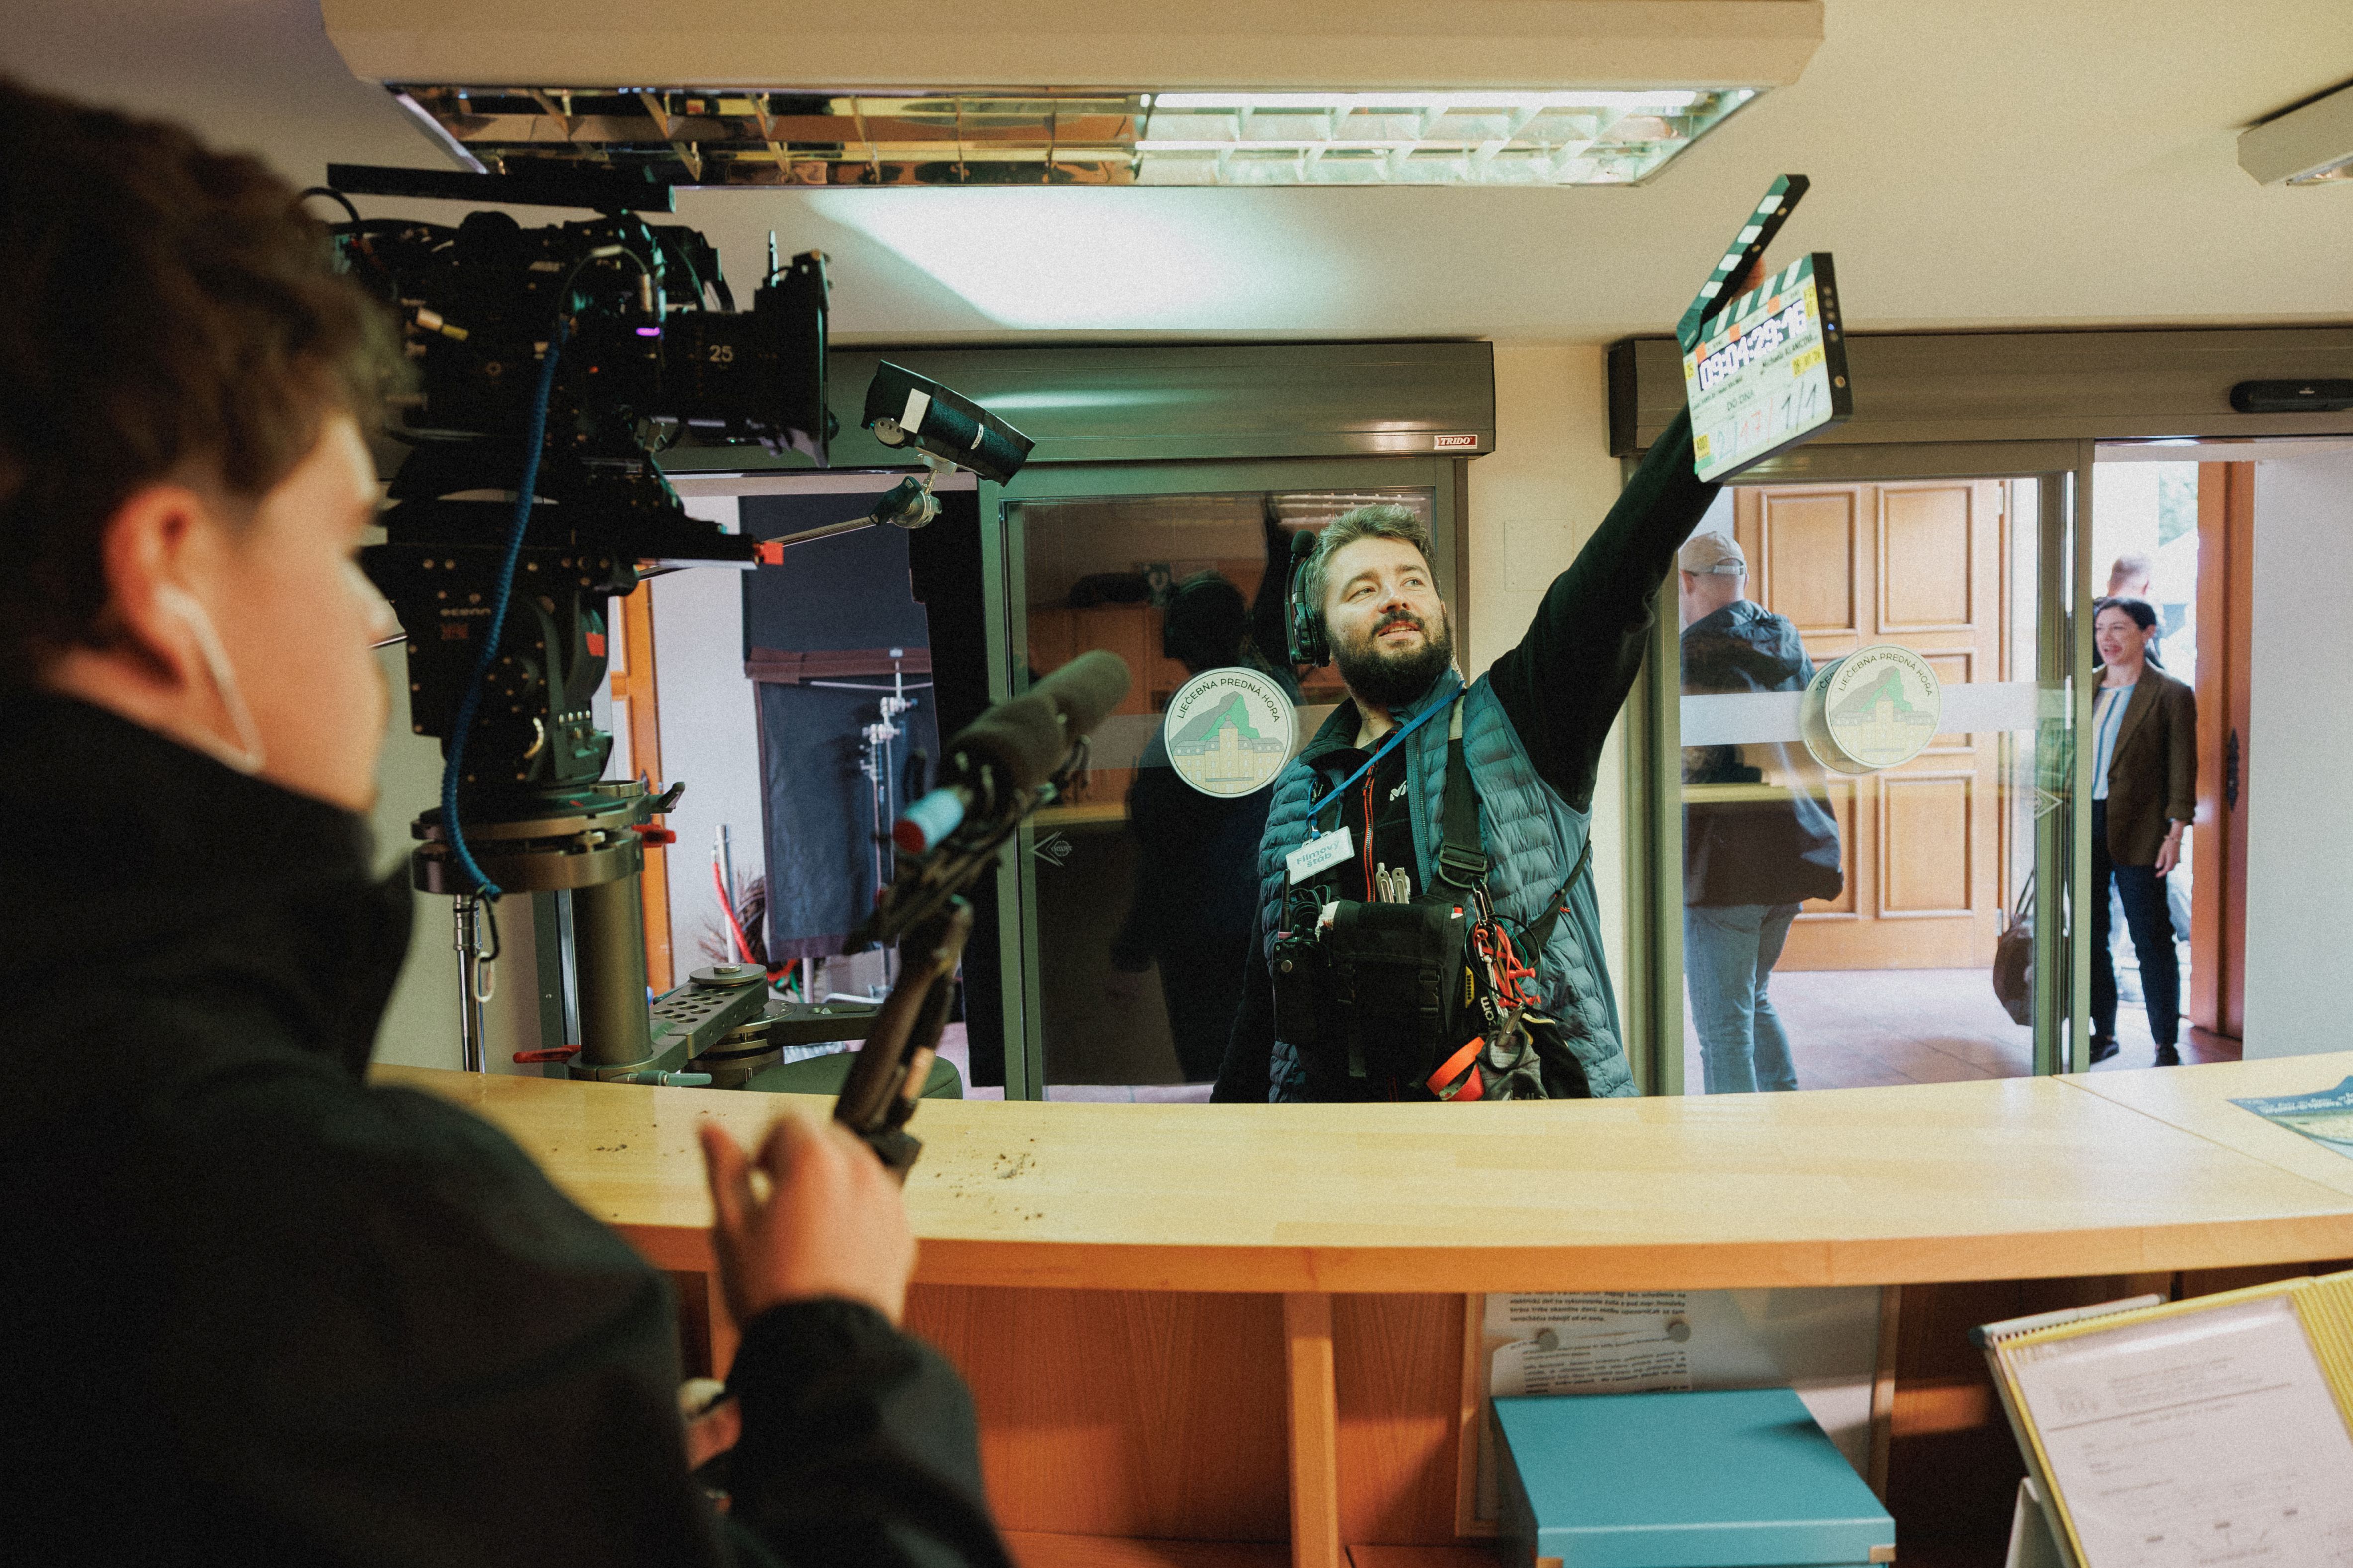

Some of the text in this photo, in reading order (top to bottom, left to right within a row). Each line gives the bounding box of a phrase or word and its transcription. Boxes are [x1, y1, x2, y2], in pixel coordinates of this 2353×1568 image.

[709, 344, 733, 362] 25
[1440, 437, 1471, 445] TRIDO
[1838, 655, 1877, 692] LIEČEBŇA
[1880, 653, 1916, 670] PREDNÁ
[1916, 669, 1933, 697] HORA
[1177, 678, 1280, 723] LIEČEBŇA PREDNÁ HORA
[1307, 852, 1332, 867] štáb
